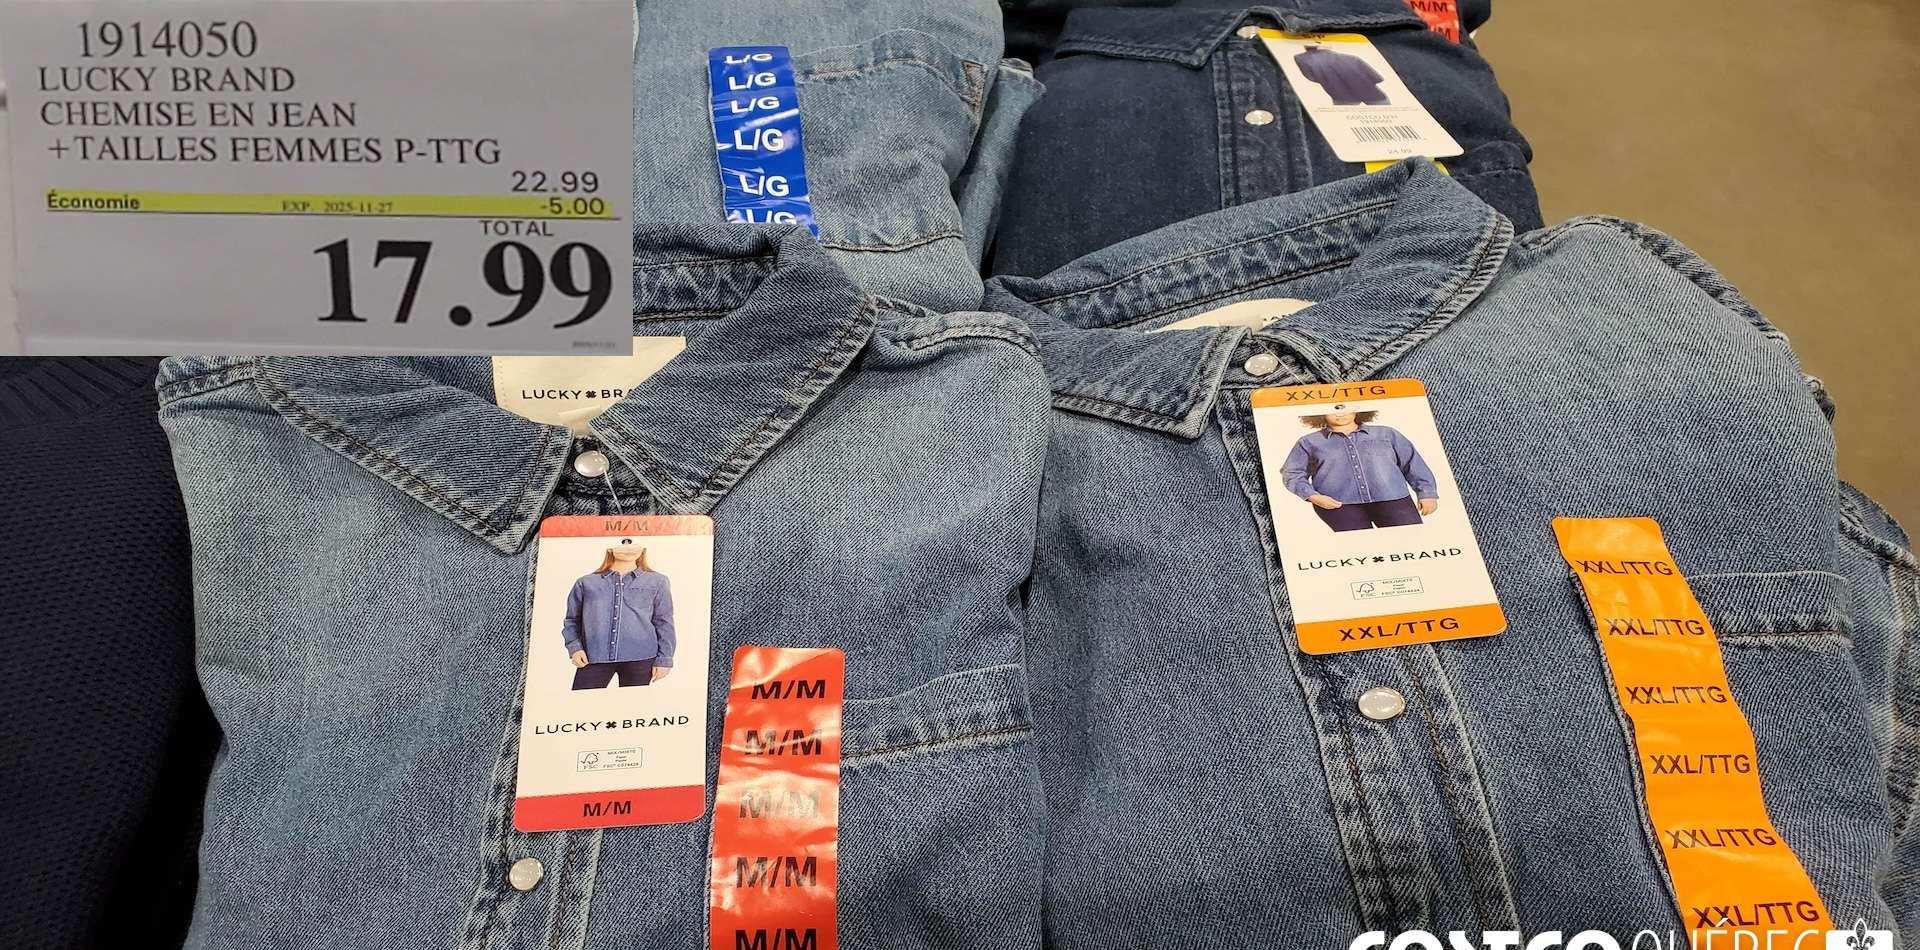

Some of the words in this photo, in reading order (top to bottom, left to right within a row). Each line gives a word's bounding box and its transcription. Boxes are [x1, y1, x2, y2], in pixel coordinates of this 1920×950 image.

[79, 20, 258, 58] 1914050
[725, 53, 773, 64] L/G
[39, 66, 156, 92] LUCKY
[171, 67, 294, 92] BRAND
[728, 72, 776, 91] L/G
[41, 101, 197, 127] CHEMISE
[209, 102, 254, 127] EN
[267, 102, 356, 128] JEAN
[731, 96, 780, 113] L/G
[734, 128, 785, 151] L/G
[48, 136, 217, 162] +TAILLES
[230, 137, 382, 164] FEMMES
[395, 138, 501, 165] P-TTG
[511, 171, 599, 193] 22.99
[739, 175, 790, 197] L/G
[47, 190, 141, 212] Économie
[282, 201, 313, 213] EXP.
[323, 201, 393, 214] 2025-11-27
[540, 197, 605, 216] -5.00
[479, 219, 554, 237] TOTAL
[314, 237, 613, 329] 17.99
[522, 389, 582, 400] LUCKY
[1286, 385, 1386, 401] XXL/TTG
[605, 519, 649, 532] M/M
[1298, 556, 1368, 571] LUCKY
[1390, 548, 1462, 562] BRAND
[1575, 560, 1673, 576] XXL/TTG
[1340, 617, 1459, 642] XXL/TTG
[1603, 618, 1704, 636] XXL/TTG
[751, 679, 826, 700] M/M
[1625, 686, 1728, 704] XXL/TTG
[535, 721, 602, 735] LUCKY
[622, 715, 689, 729] BRAND
[745, 729, 822, 756] M/M
[1650, 754, 1750, 774] XXL/TTG
[583, 800, 632, 818] M/M
[1665, 828, 1777, 849] XXL/TTG
[736, 856, 817, 888] M/M
[1692, 900, 1820, 929] XXL/TTG
[735, 928, 817, 950] M/M
